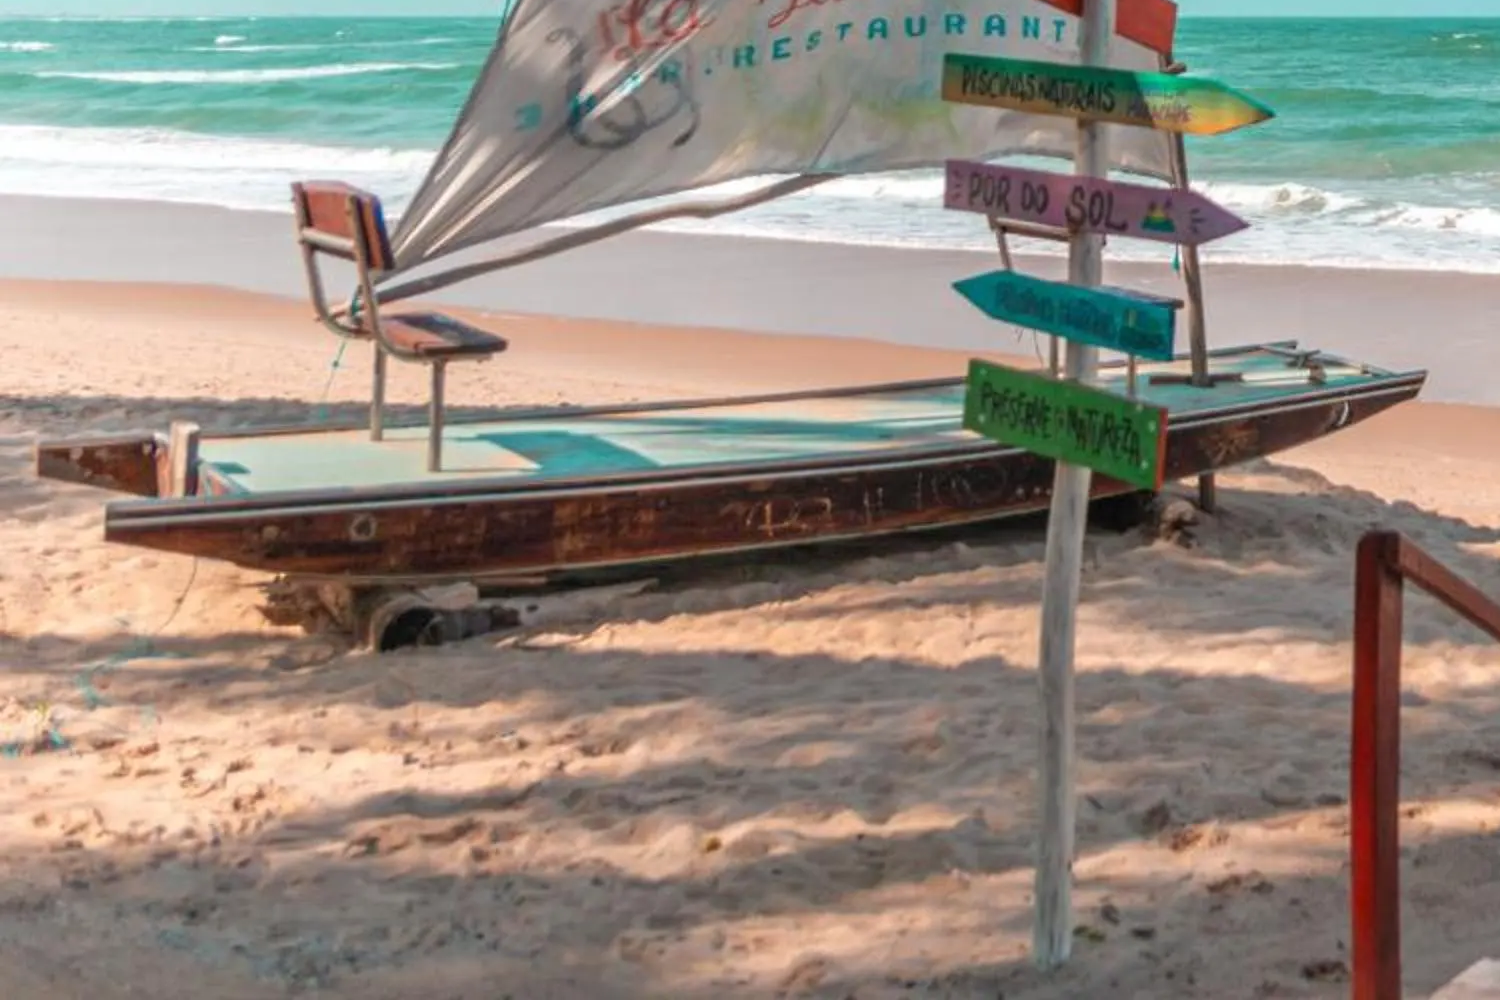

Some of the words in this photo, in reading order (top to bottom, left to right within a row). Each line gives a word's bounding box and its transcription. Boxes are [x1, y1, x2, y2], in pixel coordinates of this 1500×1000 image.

[733, 13, 1086, 68] RESTAURANT
[967, 171, 1010, 213] POR
[1020, 180, 1049, 215] DO
[1064, 184, 1128, 232] SOL
